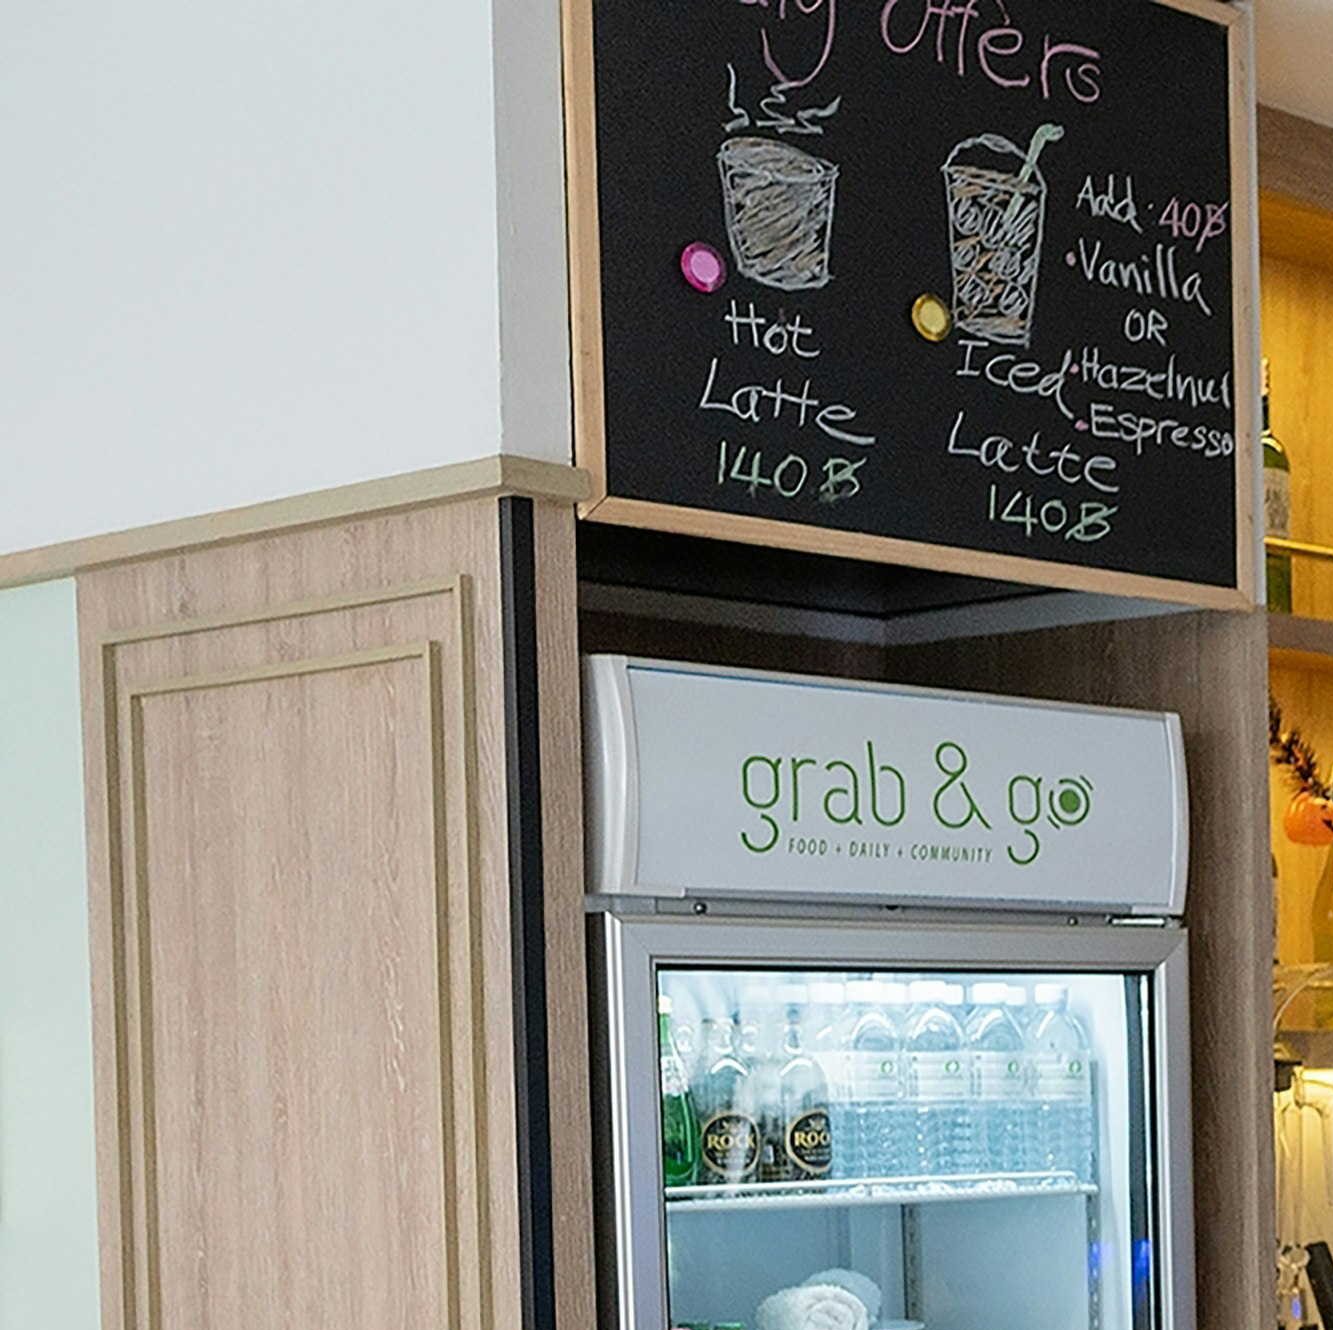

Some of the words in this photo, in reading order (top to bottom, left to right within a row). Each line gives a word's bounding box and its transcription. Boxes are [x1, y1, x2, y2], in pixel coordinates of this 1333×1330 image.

[1078, 237, 1212, 316] Vanilla
[724, 299, 821, 357] Hot
[1124, 308, 1168, 347] OR
[699, 357, 876, 445] Latte
[956, 339, 1074, 420] Iced
[948, 411, 1120, 493] Latte
[1090, 402, 1234, 456] Espresso
[741, 740, 905, 853] grab
[933, 741, 992, 830] &
[1007, 775, 1093, 865] go
[788, 838, 828, 855] FOOD
[849, 841, 890, 858] DAILY
[911, 844, 993, 863] COMMUNITY
[706, 1133, 755, 1150] ROCK
[794, 1131, 832, 1147] ROC
